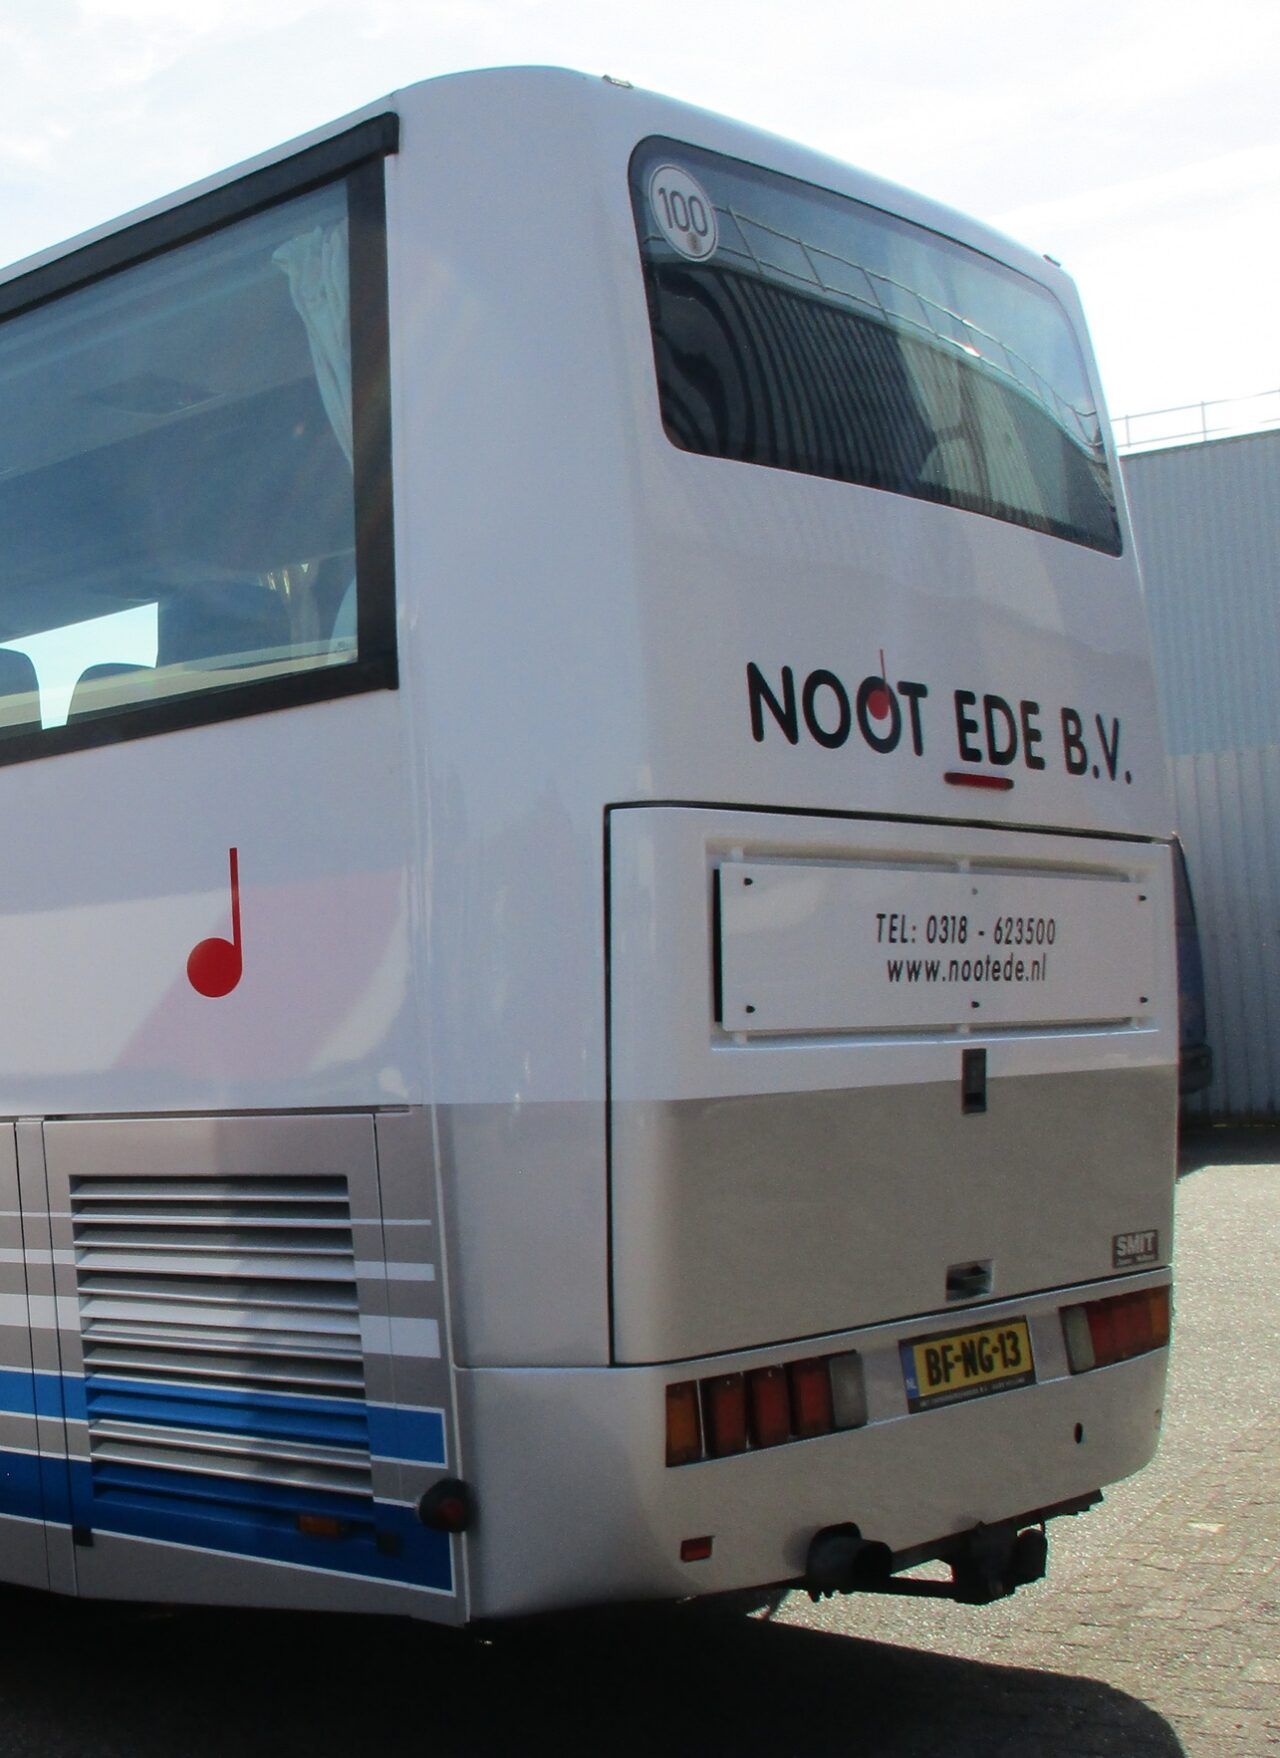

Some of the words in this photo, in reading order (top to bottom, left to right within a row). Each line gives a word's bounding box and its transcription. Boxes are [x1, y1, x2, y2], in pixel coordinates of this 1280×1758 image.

[658, 187, 709, 237] 100
[747, 661, 928, 757] NOOT
[954, 689, 1046, 771] EDE
[1060, 706, 1132, 785] B.V.
[876, 913, 917, 944] TEL:
[926, 914, 968, 945] 0318
[994, 916, 1056, 945] 623500
[887, 952, 1047, 983] www.nootede.nl
[1116, 1232, 1154, 1257] SMIT
[924, 1330, 1022, 1387] BF-NG-13
